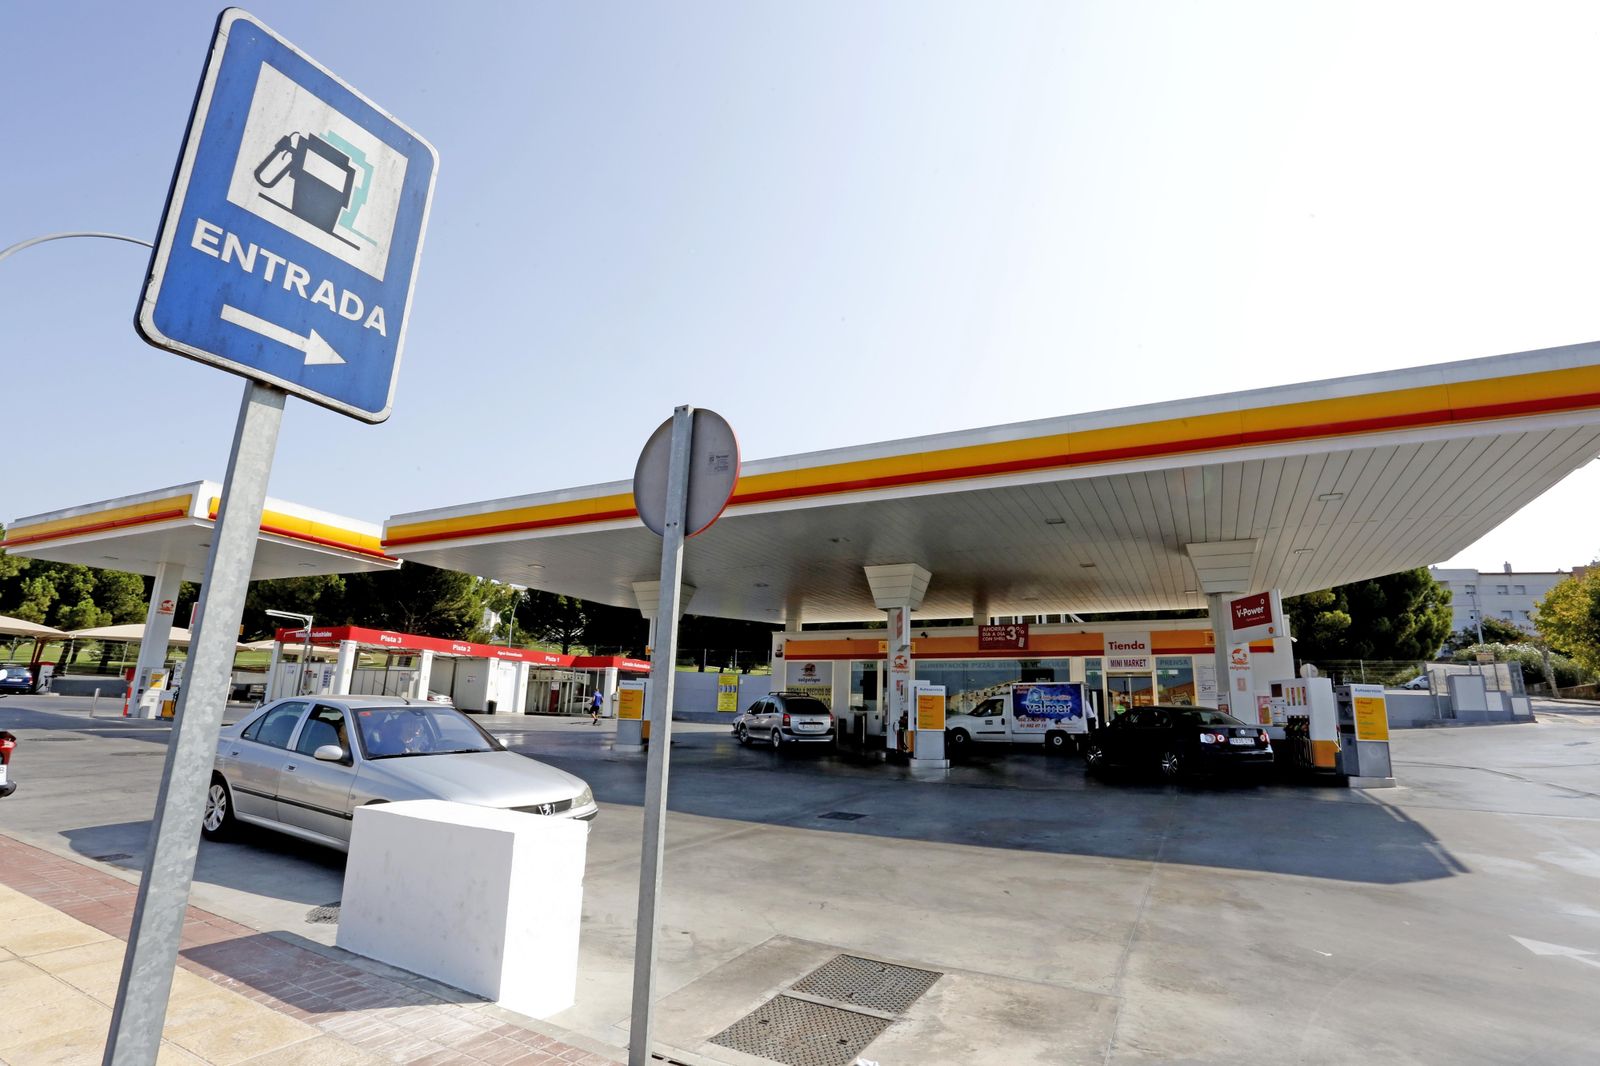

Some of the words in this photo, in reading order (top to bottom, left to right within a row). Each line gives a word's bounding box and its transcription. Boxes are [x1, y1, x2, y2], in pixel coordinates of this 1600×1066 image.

[190, 217, 388, 337] ENTRADA
[1236, 606, 1264, 618] V-Power
[380, 634, 398, 643] Pista
[1108, 640, 1145, 650] Tienda
[1110, 660, 1123, 668] MINI
[1124, 659, 1146, 667] MARKET
[1026, 700, 1072, 714] valmar
